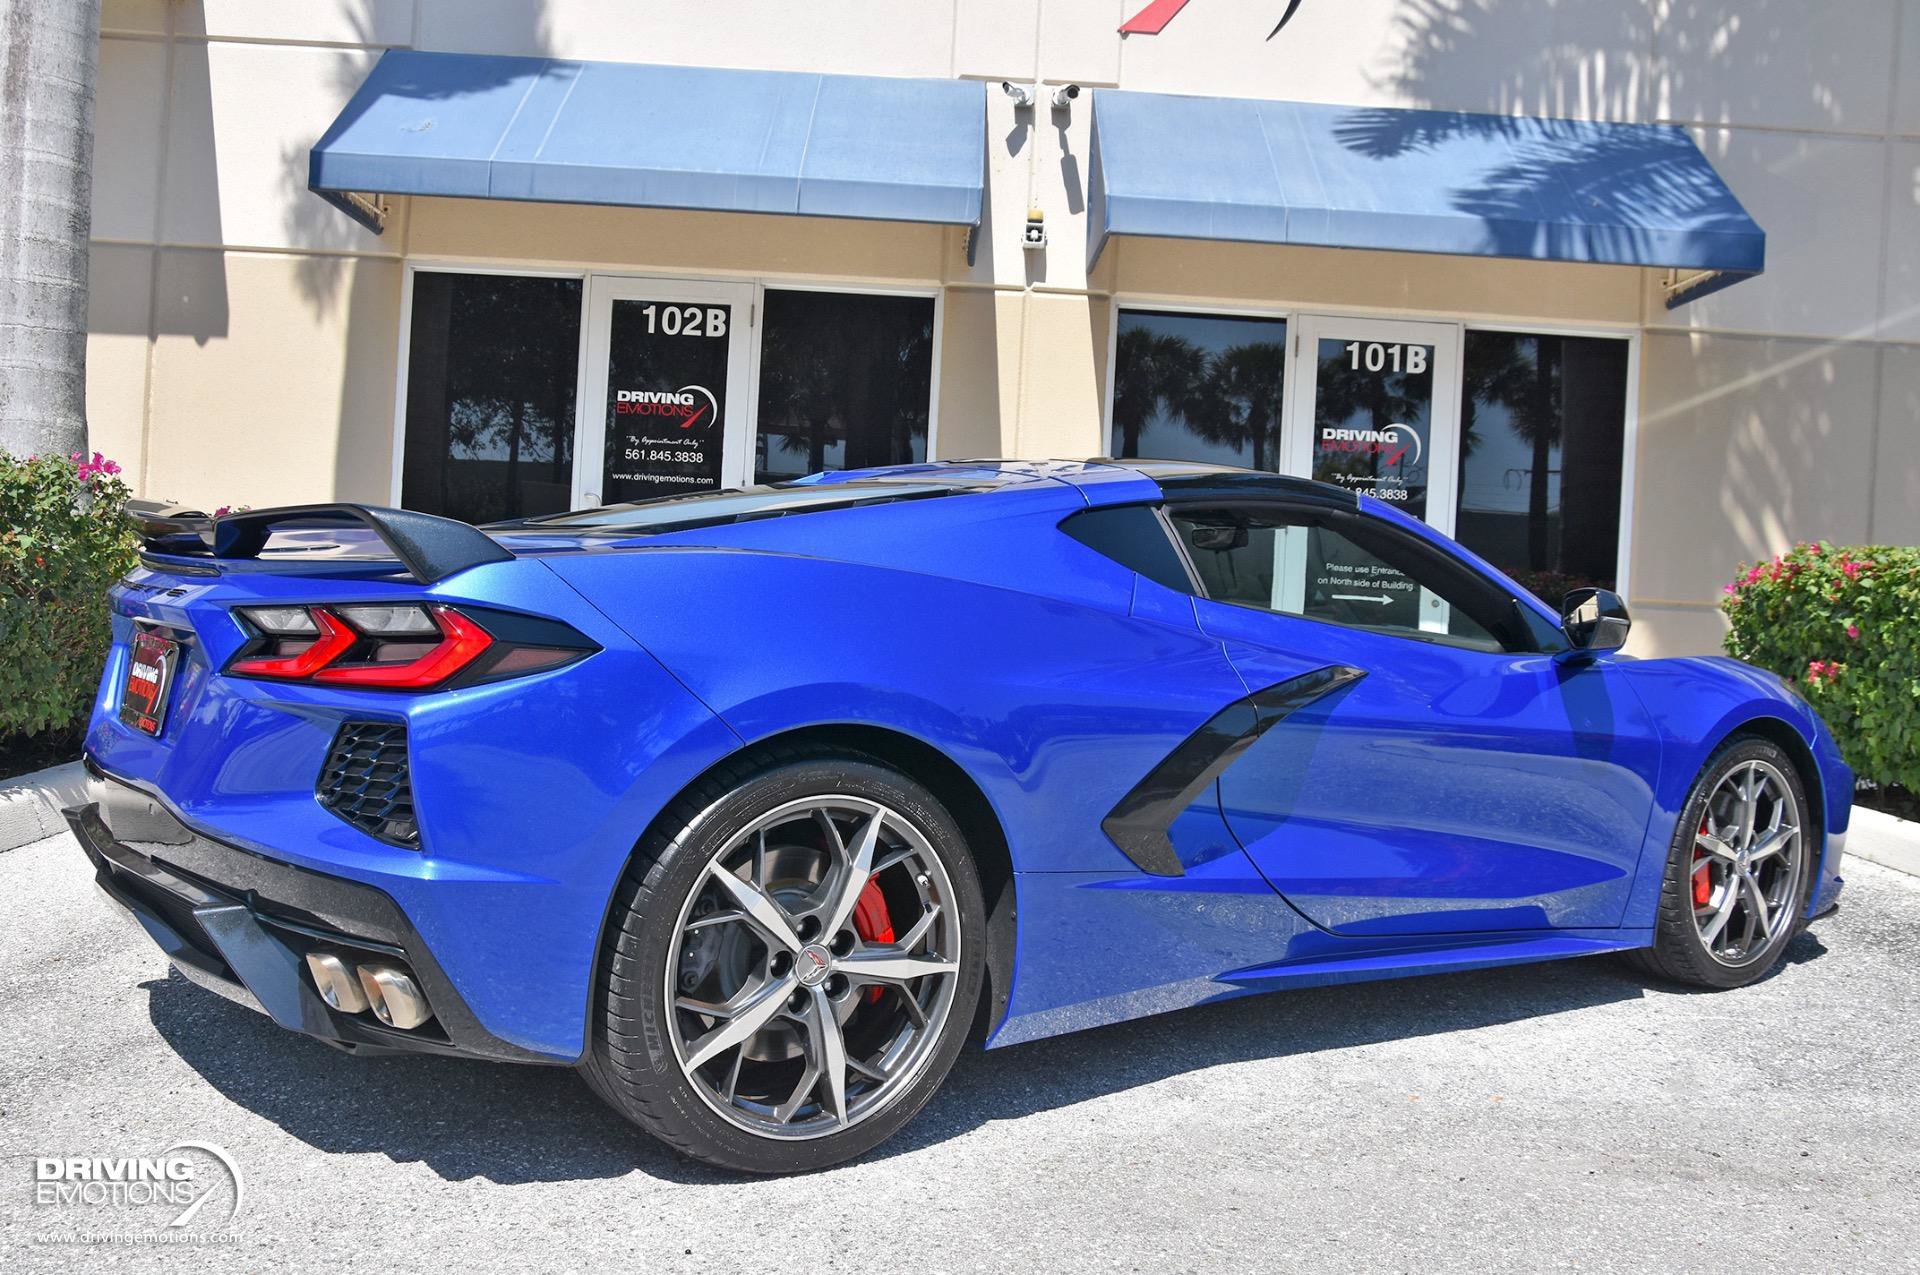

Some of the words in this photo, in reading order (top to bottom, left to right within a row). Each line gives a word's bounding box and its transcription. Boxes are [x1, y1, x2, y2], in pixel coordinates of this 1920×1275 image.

[642, 305, 727, 337] 102B
[1346, 342, 1427, 374] 101B
[617, 390, 694, 405] DRIVING
[616, 402, 694, 417] EMOTIONS
[1322, 428, 1398, 443] DRIVING
[624, 448, 704, 463] 561.845.3838
[612, 473, 714, 484] www.drivingemotions.com
[1326, 562, 1353, 573] Please
[1354, 566, 1369, 574] use
[1317, 577, 1328, 585] on
[1330, 577, 1352, 586] North
[1353, 579, 1370, 588] side
[1372, 580, 1380, 589] of
[1381, 582, 1414, 592] Building
[132, 662, 159, 684] DRIVING
